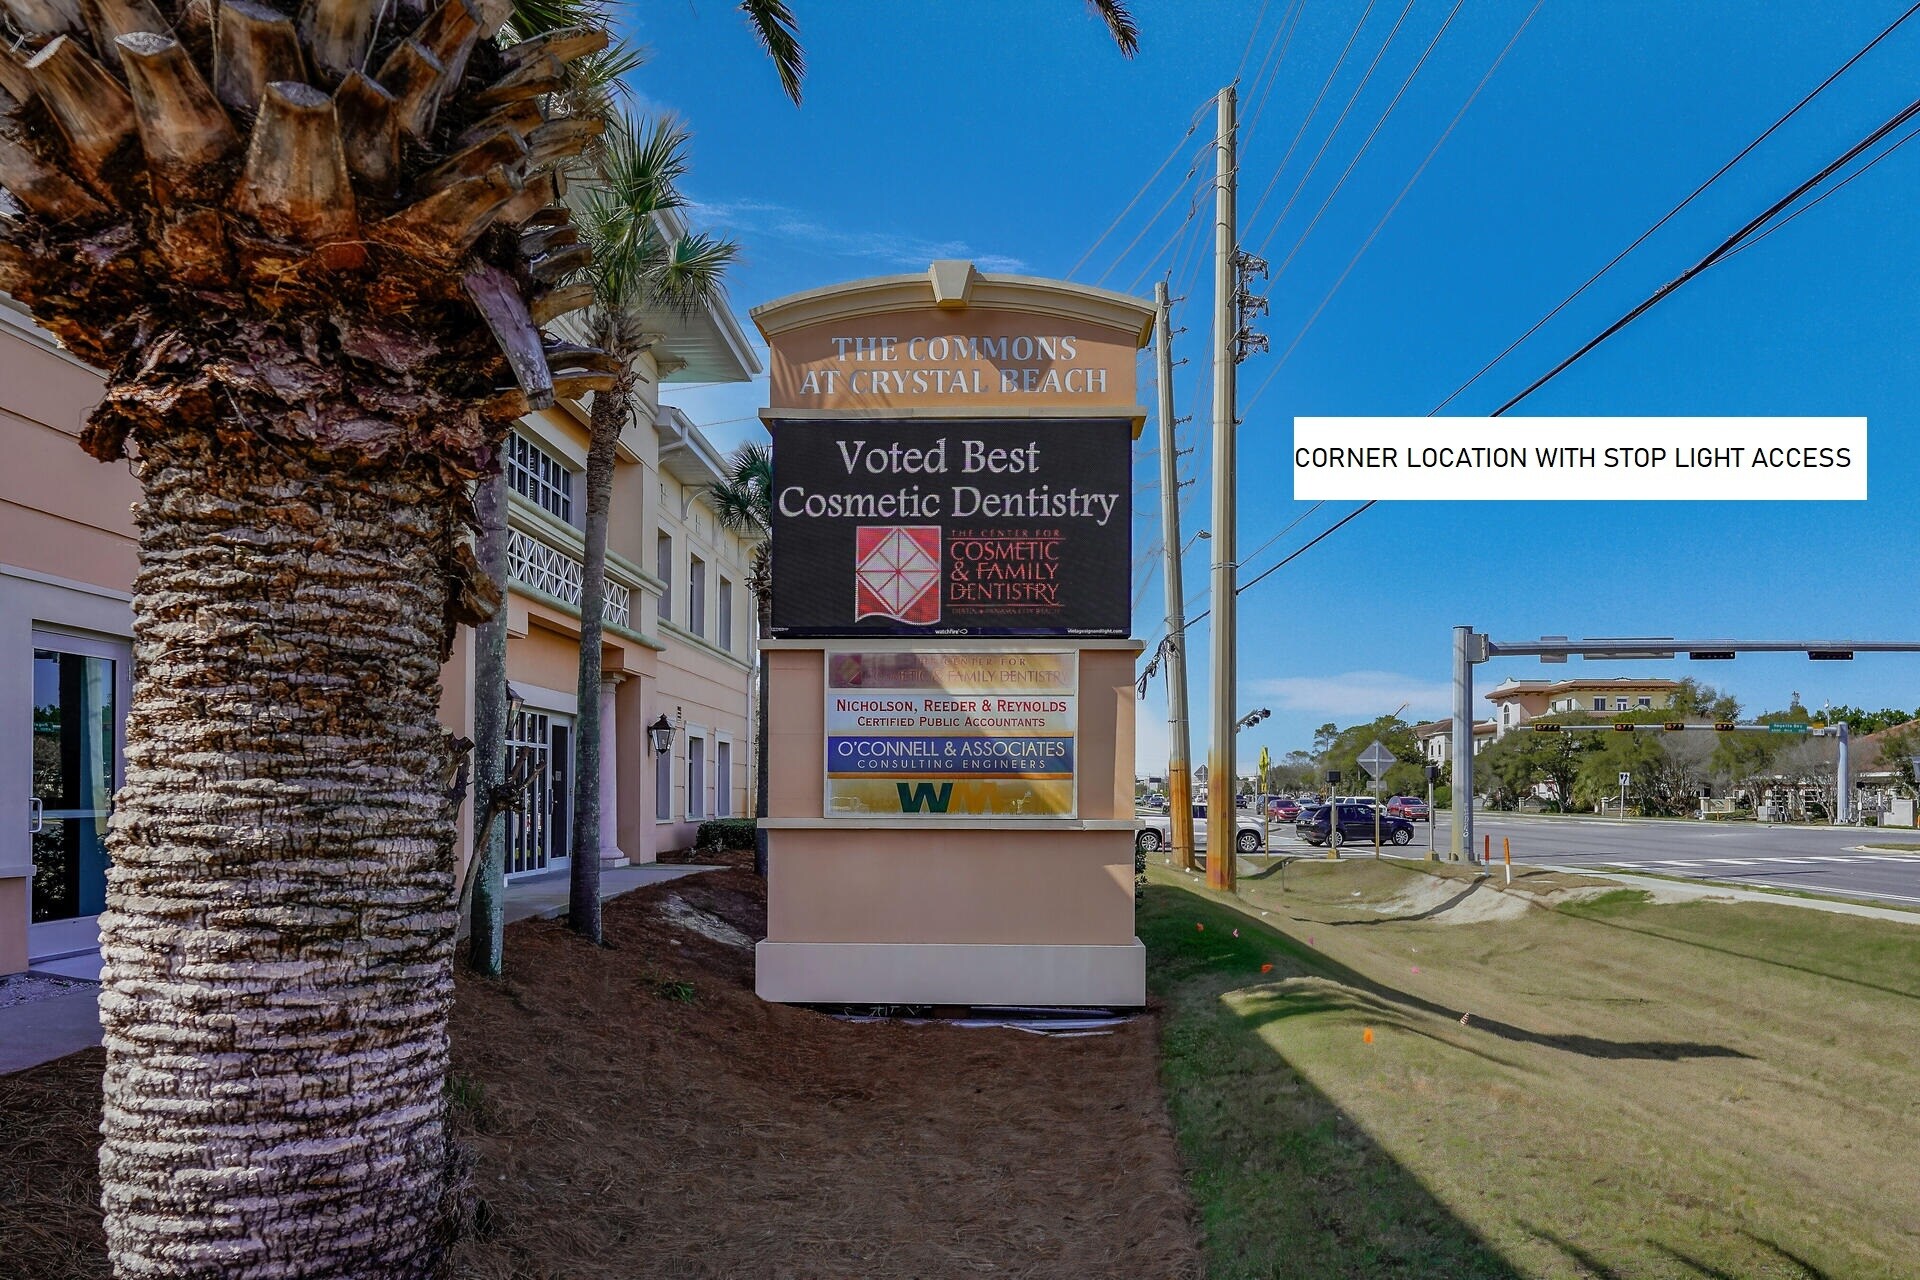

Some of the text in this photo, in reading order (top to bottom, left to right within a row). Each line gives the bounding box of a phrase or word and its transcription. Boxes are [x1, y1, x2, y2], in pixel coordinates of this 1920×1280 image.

[832, 335, 1077, 361] THE COMMONS
[799, 368, 1108, 395] AT CRYSTAL BEACH
[836, 438, 1040, 474] Voted Best
[778, 485, 1120, 526] Cosmetic Dentistry
[951, 529, 1060, 537] THE CENTER FOR
[950, 541, 1059, 561] COSMETIC
[950, 561, 1059, 581] & FAMILY
[950, 583, 1060, 605] DENTISTRY
[943, 656, 993, 666] CENTER
[1001, 657, 1026, 666] FOR
[948, 670, 996, 682] FAMILY
[1000, 670, 1069, 685] DENTISTRY
[836, 699, 1067, 714] NICHOLSON, REEDER & REYNOLDS
[857, 716, 1046, 727] CERTIFIED PUBLIC ACCOUNTANTS
[837, 741, 1065, 757] O'CONNELL & ASSOCIATES
[857, 759, 1046, 769] CONSULTING ENGINEERS
[896, 782, 1001, 813] WM
